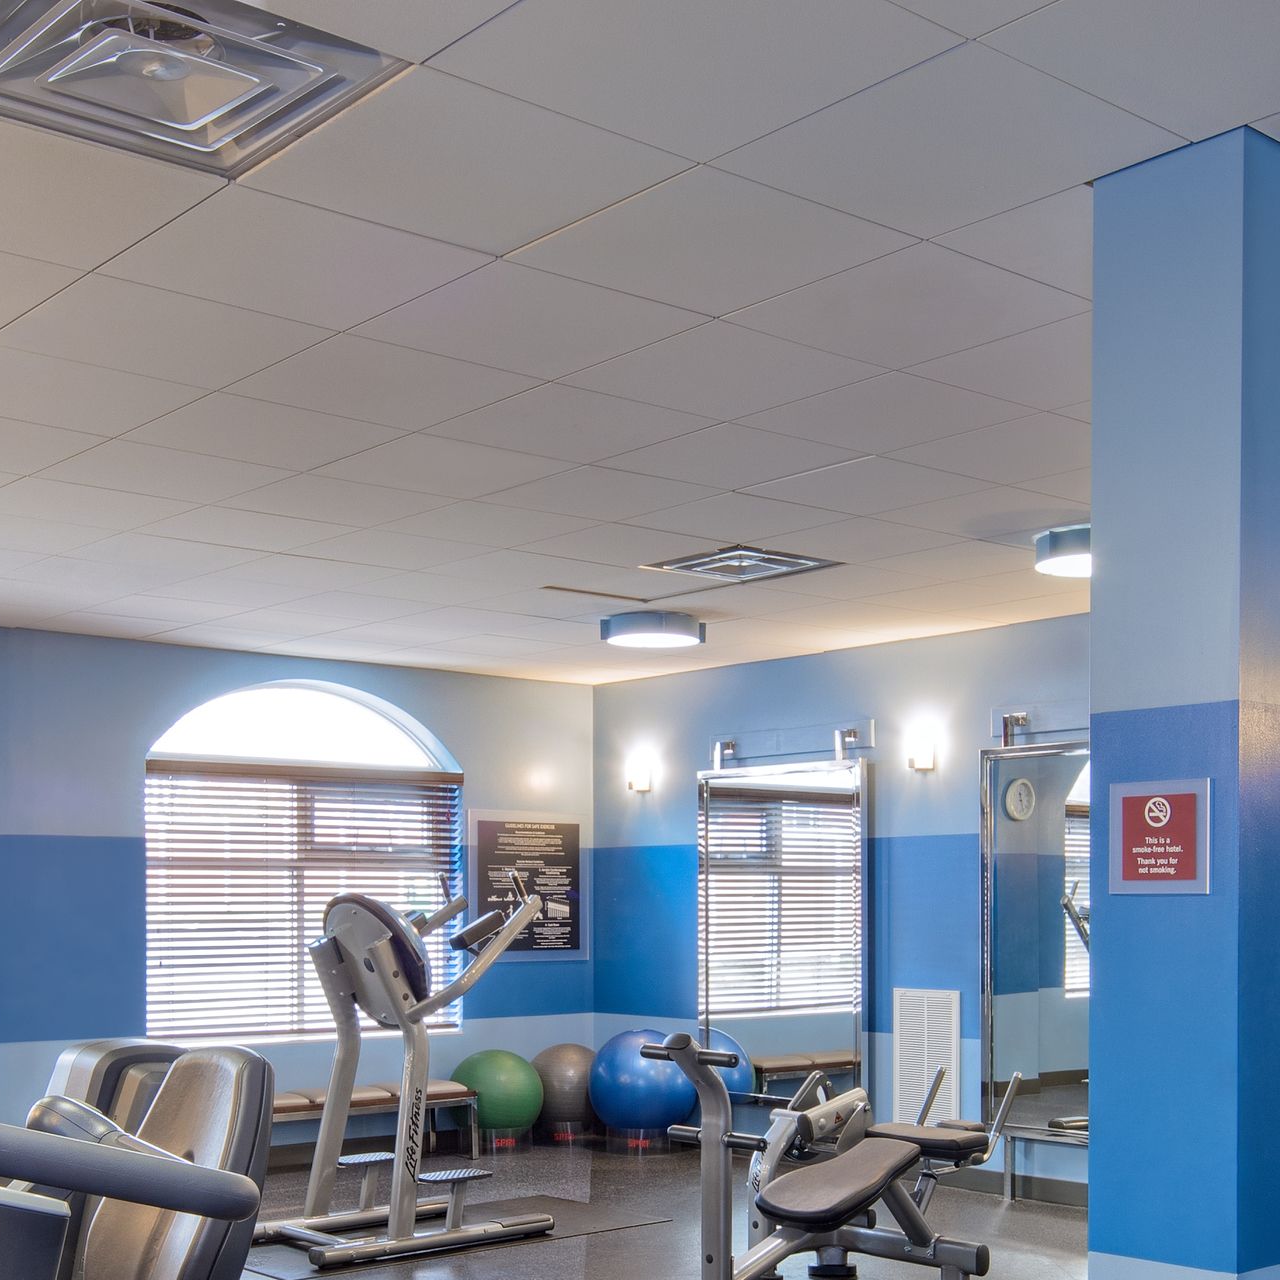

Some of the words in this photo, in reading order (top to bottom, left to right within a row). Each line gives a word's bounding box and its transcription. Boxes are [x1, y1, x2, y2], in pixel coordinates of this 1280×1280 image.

[1145, 836, 1158, 844] This
[1159, 836, 1165, 844] is
[1132, 845, 1165, 853] smoke-free
[1137, 857, 1156, 865] Thank
[1157, 858, 1168, 866] you
[409, 1087, 423, 1148] Fitness
[405, 1145, 418, 1183] Life
